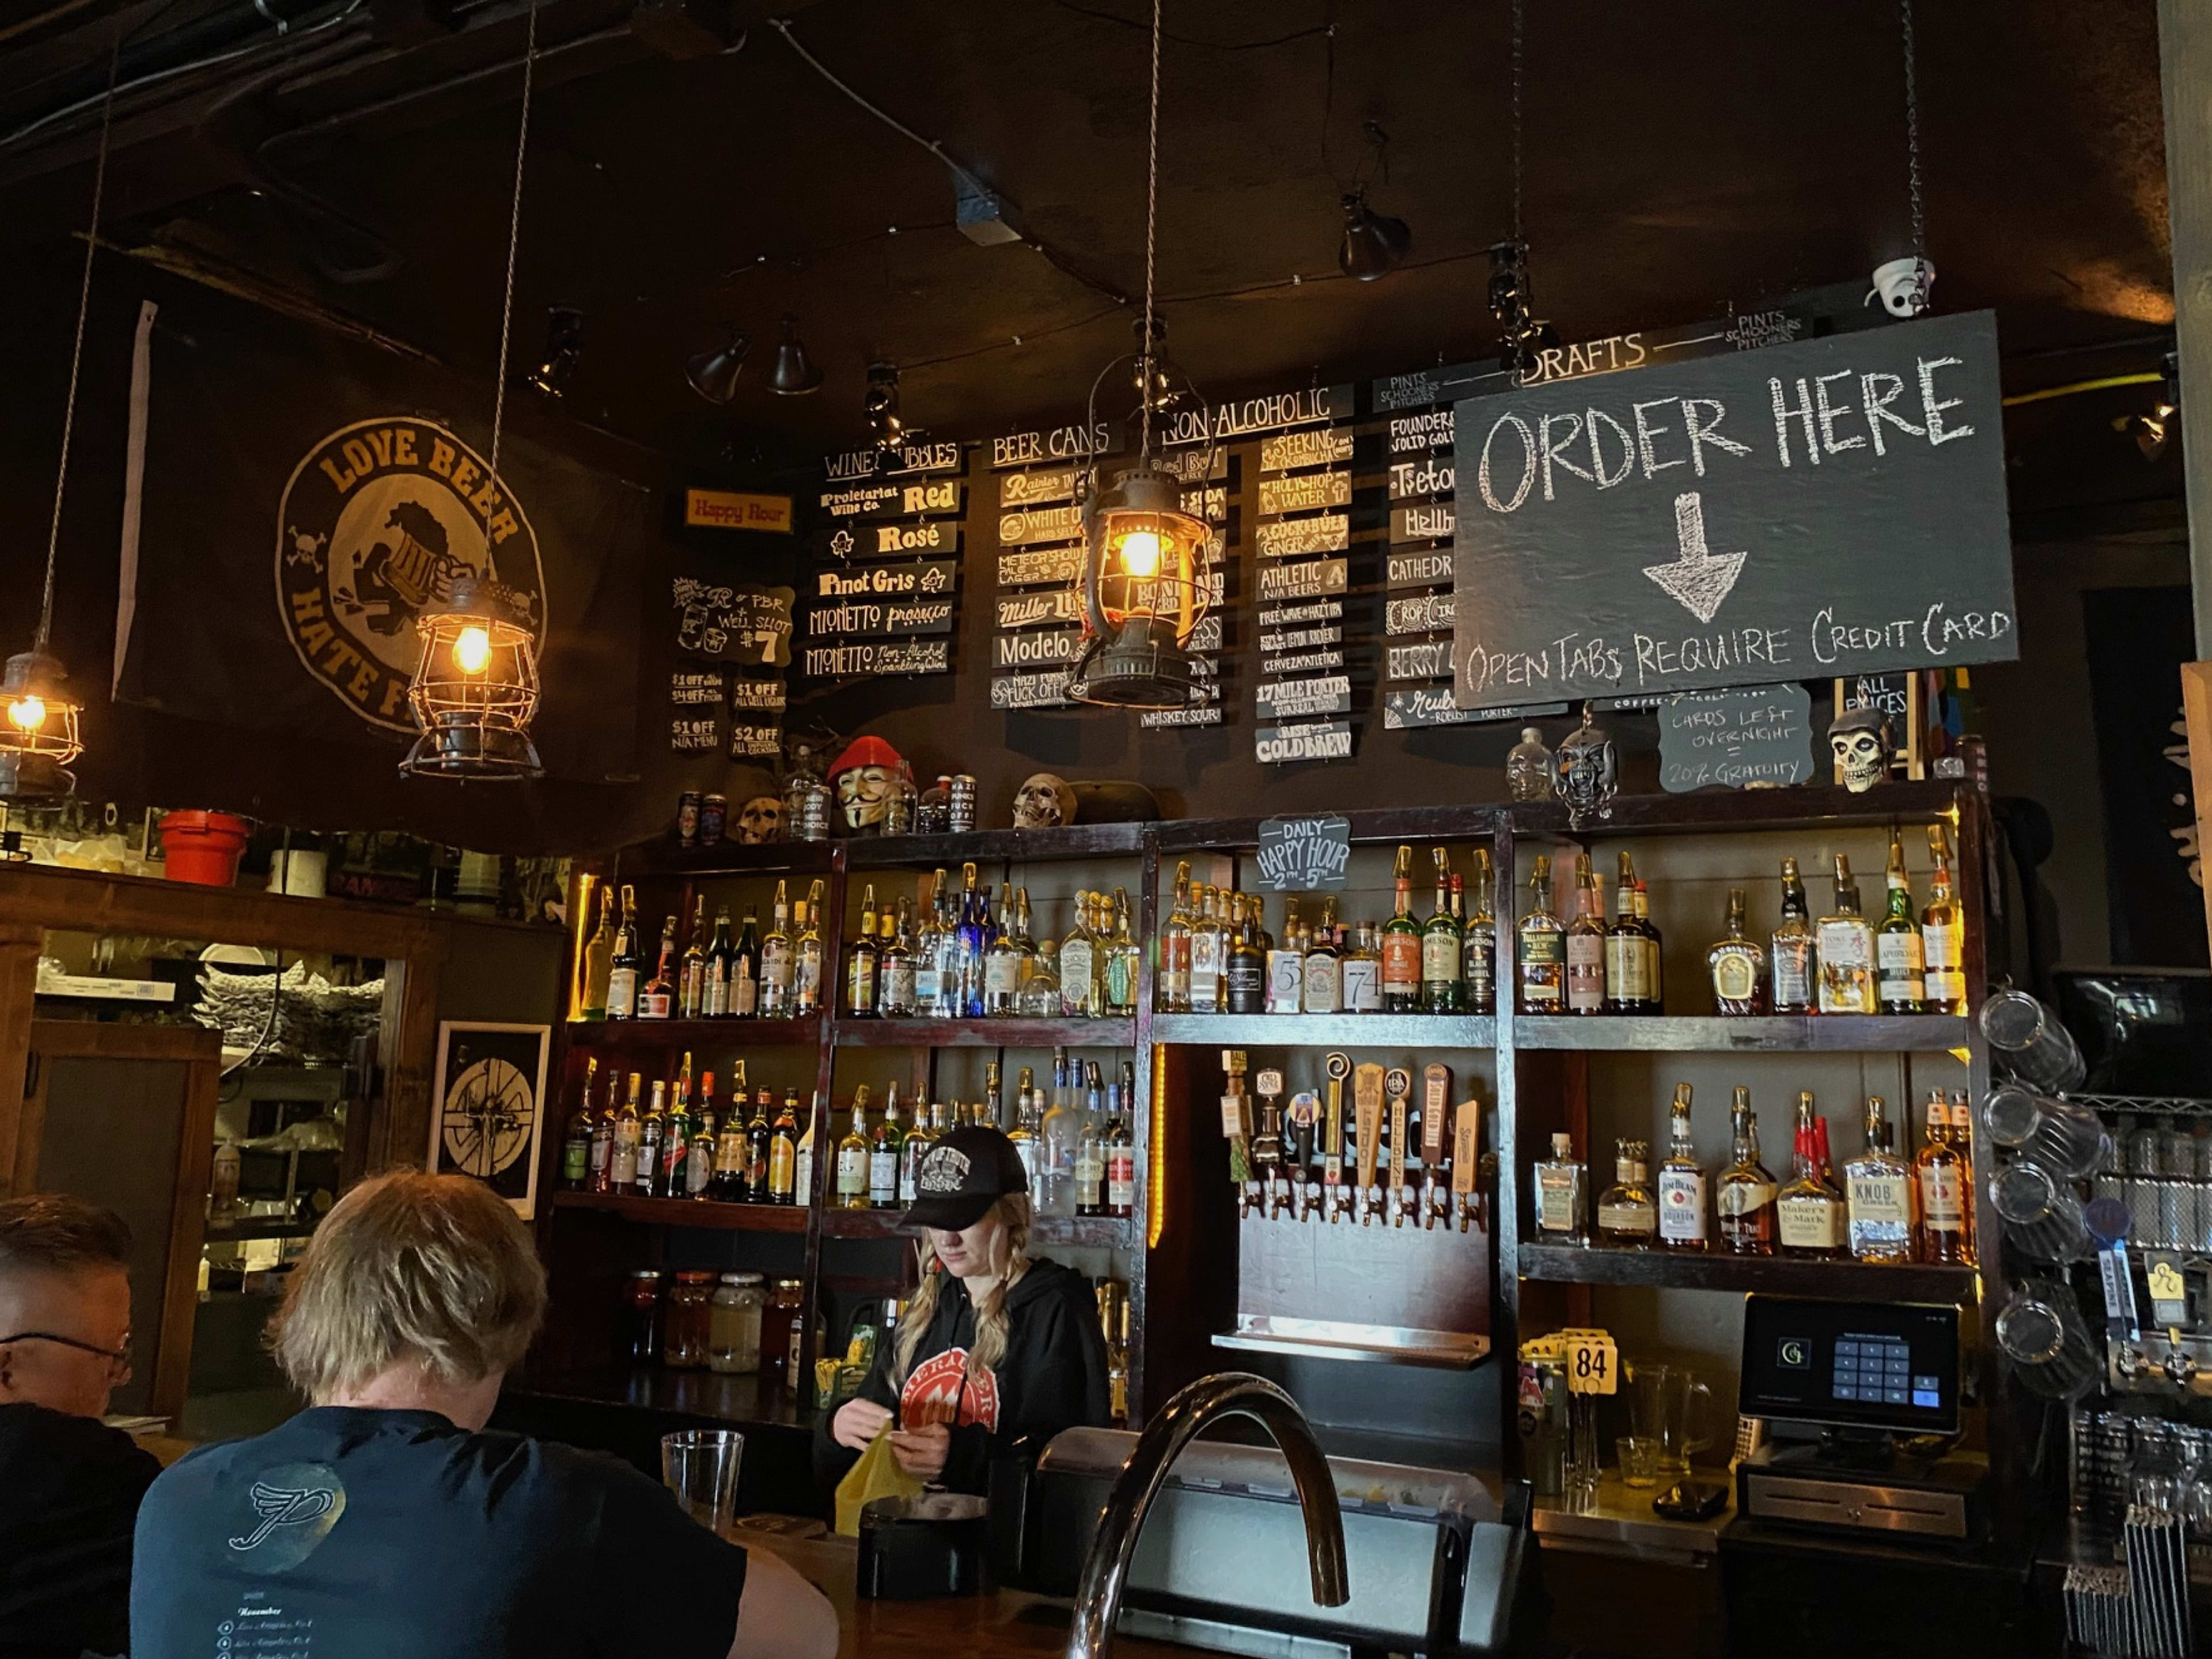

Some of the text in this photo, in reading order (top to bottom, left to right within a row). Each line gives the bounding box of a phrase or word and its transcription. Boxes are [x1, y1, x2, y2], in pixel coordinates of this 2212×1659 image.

[1725, 319, 1801, 343] SCHOONERS
[1738, 311, 1785, 329] PINTS
[1380, 382, 1439, 404] SCHOONERS
[1391, 373, 1427, 390] PINTS
[994, 423, 1109, 464] BEER CANS
[1479, 357, 1975, 513] ORDER HERE
[825, 450, 874, 477] WINE
[320, 429, 520, 544] LOVE BEER
[1005, 474, 1059, 499] Rainier
[1309, 472, 1335, 490] HOP
[821, 482, 955, 513] Proletariat Red
[1281, 490, 1326, 507] WATER
[695, 499, 784, 524] Happy Hour
[1026, 508, 1069, 529] WHITE
[1406, 509, 1455, 536] Hellb
[877, 523, 941, 553] Rosé
[1261, 536, 1306, 556] GINGER
[999, 573, 1040, 585] LAGER
[1261, 562, 1321, 590] ATHLETIC
[1388, 555, 1452, 583] CATHEDR
[819, 569, 916, 596] Pinot Gris
[1264, 581, 1321, 600] N/A BEERS
[751, 594, 785, 612] PBR
[998, 597, 1054, 624] Miller
[755, 616, 793, 634] SHOT
[809, 605, 952, 635] MIONETTO prosecco
[1259, 609, 1281, 626] FREE
[292, 586, 380, 703] HATE
[1000, 631, 1070, 665] Modelo
[1467, 603, 2011, 692] OPEN TABS REQUIRE CREDIT CARD
[806, 646, 873, 675] MIONETTO
[1264, 656, 1303, 672] CERVEZA
[1389, 643, 1444, 679] BERRY
[736, 683, 778, 696] $1 OFF
[1013, 675, 1036, 687] NAZI
[1305, 675, 1351, 696] PORTER
[1861, 677, 1890, 695] ALL
[1008, 683, 1037, 705] FUCK
[1845, 690, 1907, 715] PICES
[672, 720, 715, 735] $1 OFF
[1142, 707, 1217, 726] WHISKEY SOUR
[1672, 705, 1793, 729] CARDS LEFT
[694, 735, 718, 748] MENU
[734, 726, 778, 741] $2 OFF
[1693, 727, 1798, 748] OVERNIGHT
[1256, 732, 1351, 763] COLD BREW
[1715, 760, 1799, 784] GRATUITY
[1283, 819, 1324, 839] DAILY
[1256, 836, 1350, 879] HAPPY HOUR
[1393, 1106, 1403, 1186] HELLBENT
[1855, 1184, 1892, 1200] KNOB
[1793, 1214, 1825, 1224] Mark
[1575, 1348, 1608, 1379] 84
